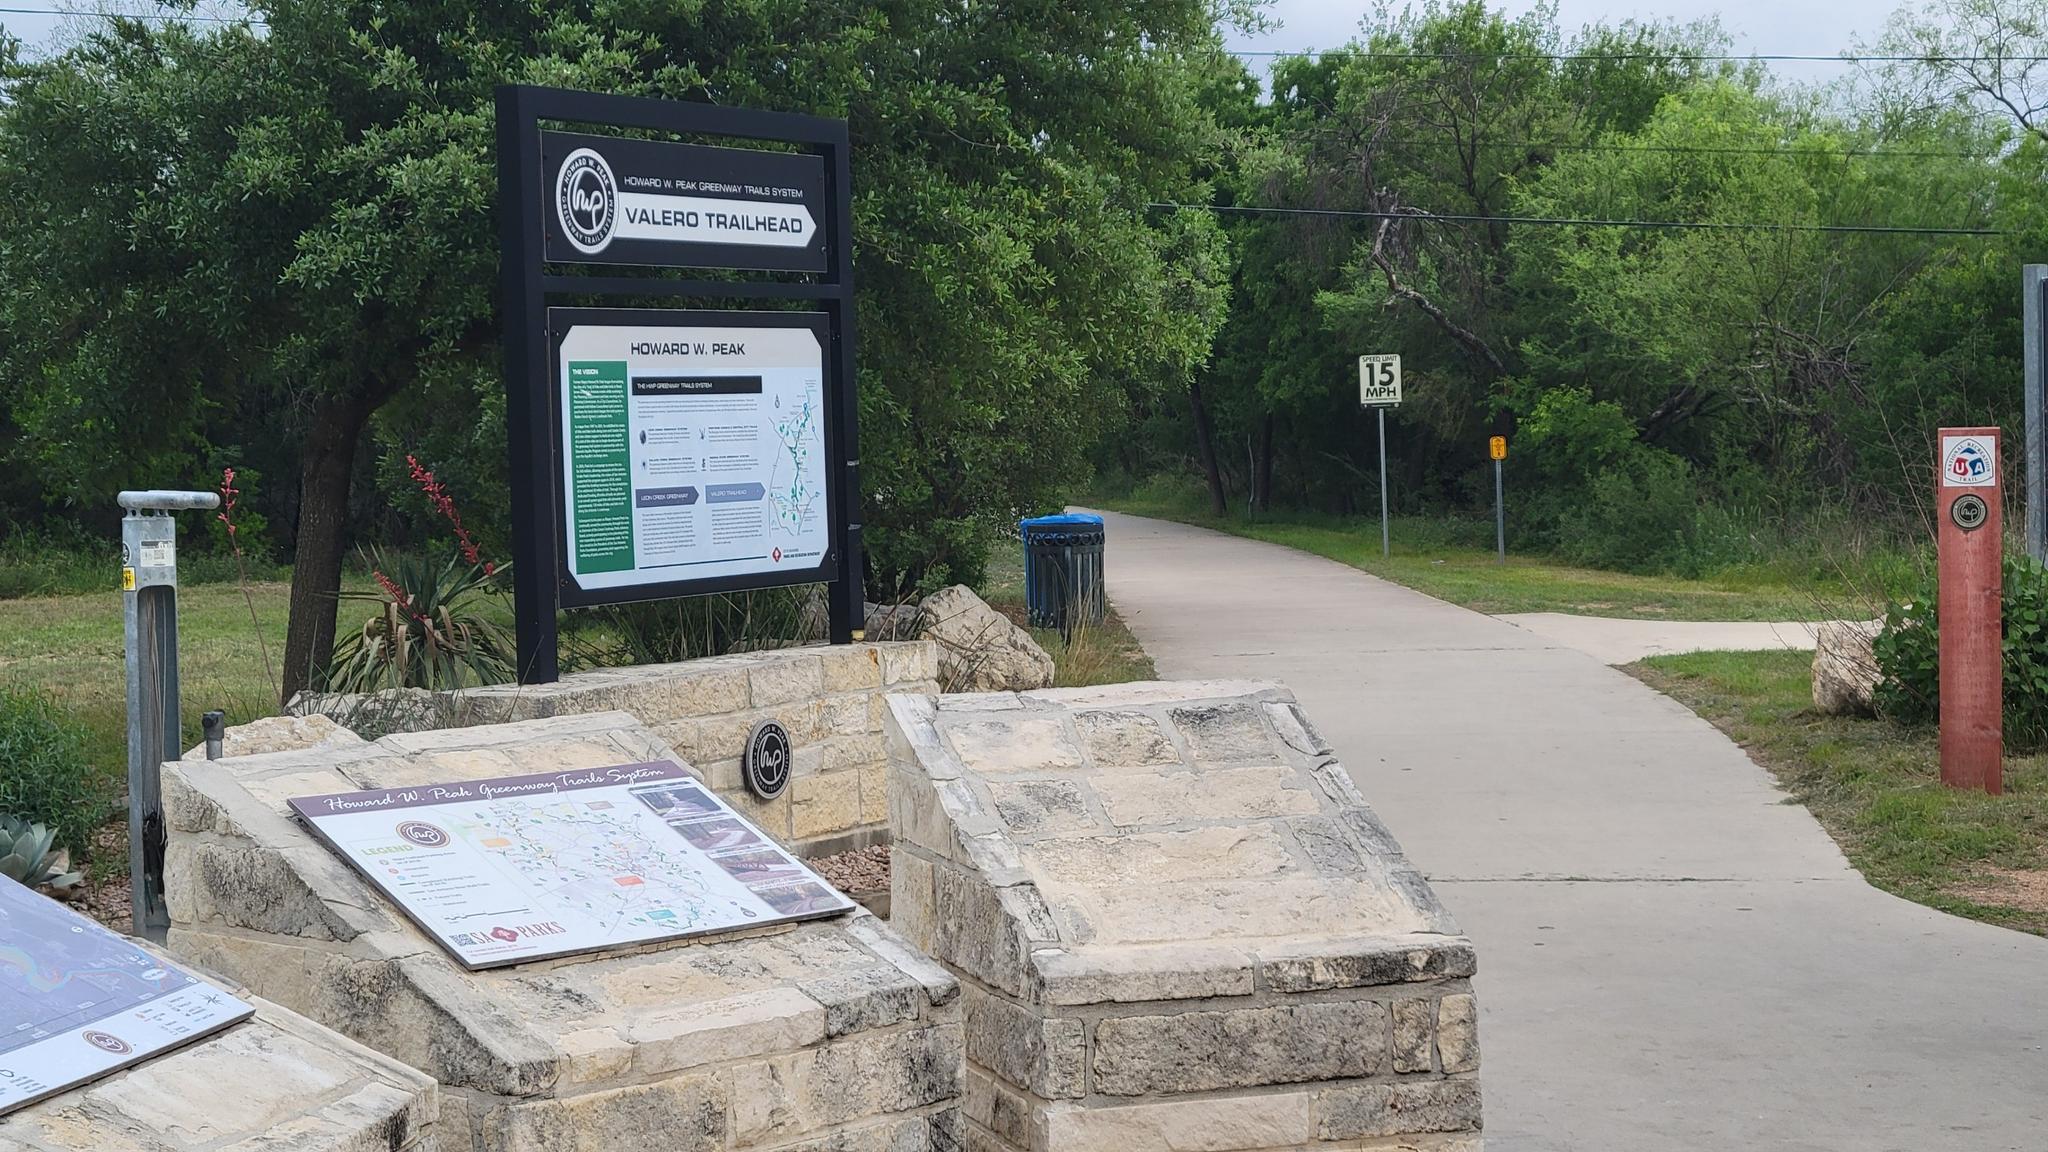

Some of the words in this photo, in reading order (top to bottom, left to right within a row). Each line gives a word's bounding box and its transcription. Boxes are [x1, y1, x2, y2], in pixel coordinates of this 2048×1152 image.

[564, 157, 587, 184] HOWARD
[596, 165, 609, 185] PEAK
[624, 176, 662, 188] HOWARD
[663, 179, 673, 188] W.
[675, 180, 697, 190] PEAK
[699, 182, 743, 193] GREENWAY
[744, 185, 770, 196] TRAILS
[771, 187, 803, 198] SYSTEM
[562, 196, 583, 241] GREENWAY
[584, 233, 604, 245] TRAILS
[602, 199, 613, 233] SYSTEM
[624, 207, 699, 228] VALERO
[705, 212, 803, 233] TRAILHEAD
[630, 342, 690, 356] HOWARD
[693, 342, 708, 356] W.
[712, 343, 746, 356] PEAK
[695, 381, 713, 389] SYSTEM
[1366, 362, 1394, 386] 15
[1366, 387, 1396, 398] MPH
[1947, 445, 1963, 472] NATIONAL
[1967, 442, 1991, 472] RECREATION
[323, 793, 395, 811] Howard
[397, 791, 425, 803] W.
[428, 786, 473, 800] Peak
[479, 780, 560, 800] Greenway
[556, 771, 605, 787] Trails
[606, 768, 665, 786] System
[361, 844, 414, 856] LEGEND
[469, 931, 495, 945] SA
[515, 921, 567, 938] PARKS
